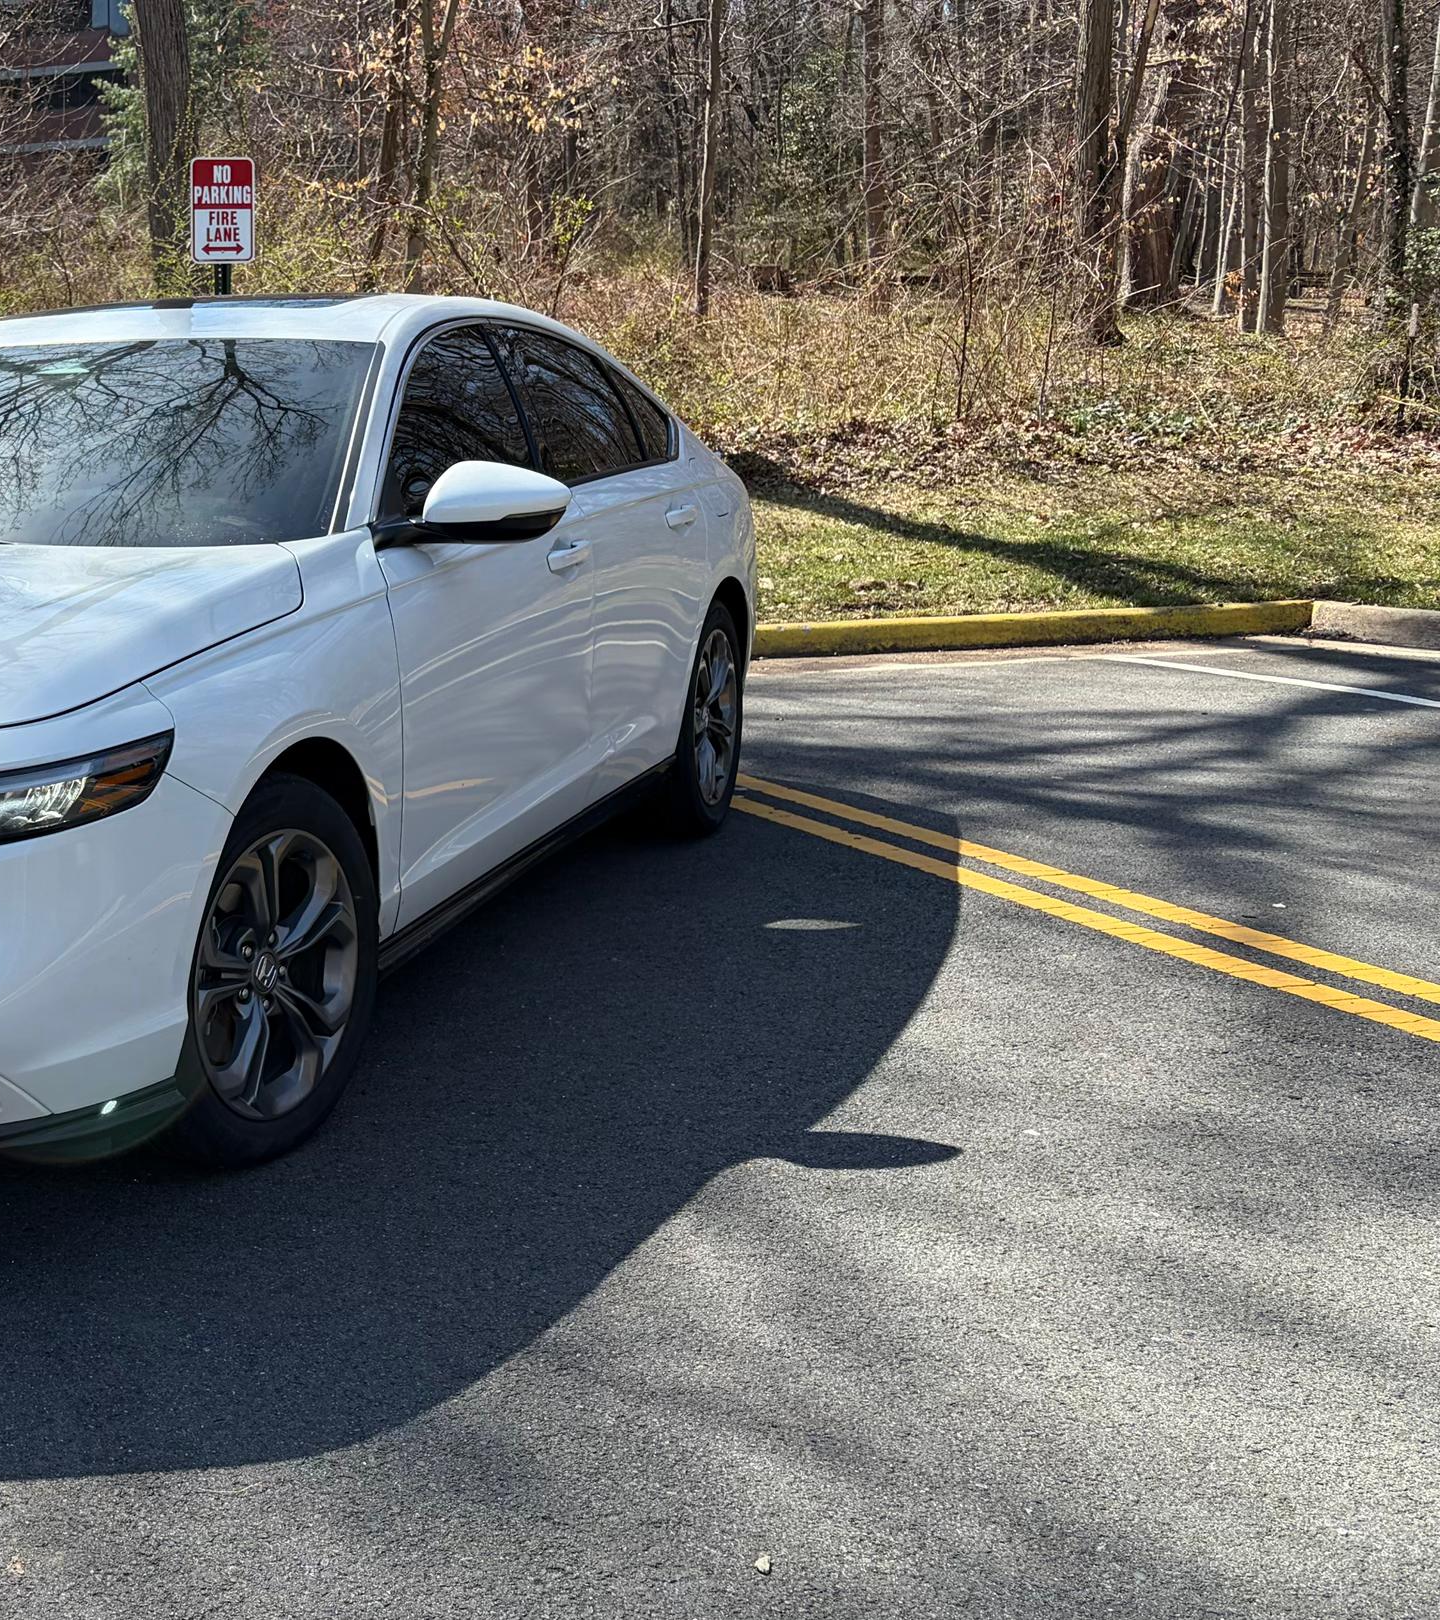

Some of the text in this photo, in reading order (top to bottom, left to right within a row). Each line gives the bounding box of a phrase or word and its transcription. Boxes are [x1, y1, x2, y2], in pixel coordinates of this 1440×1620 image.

[213, 165, 231, 184] NO
[194, 186, 251, 204] PARKING
[209, 211, 237, 225] FIRE
[206, 228, 240, 242] LANE
